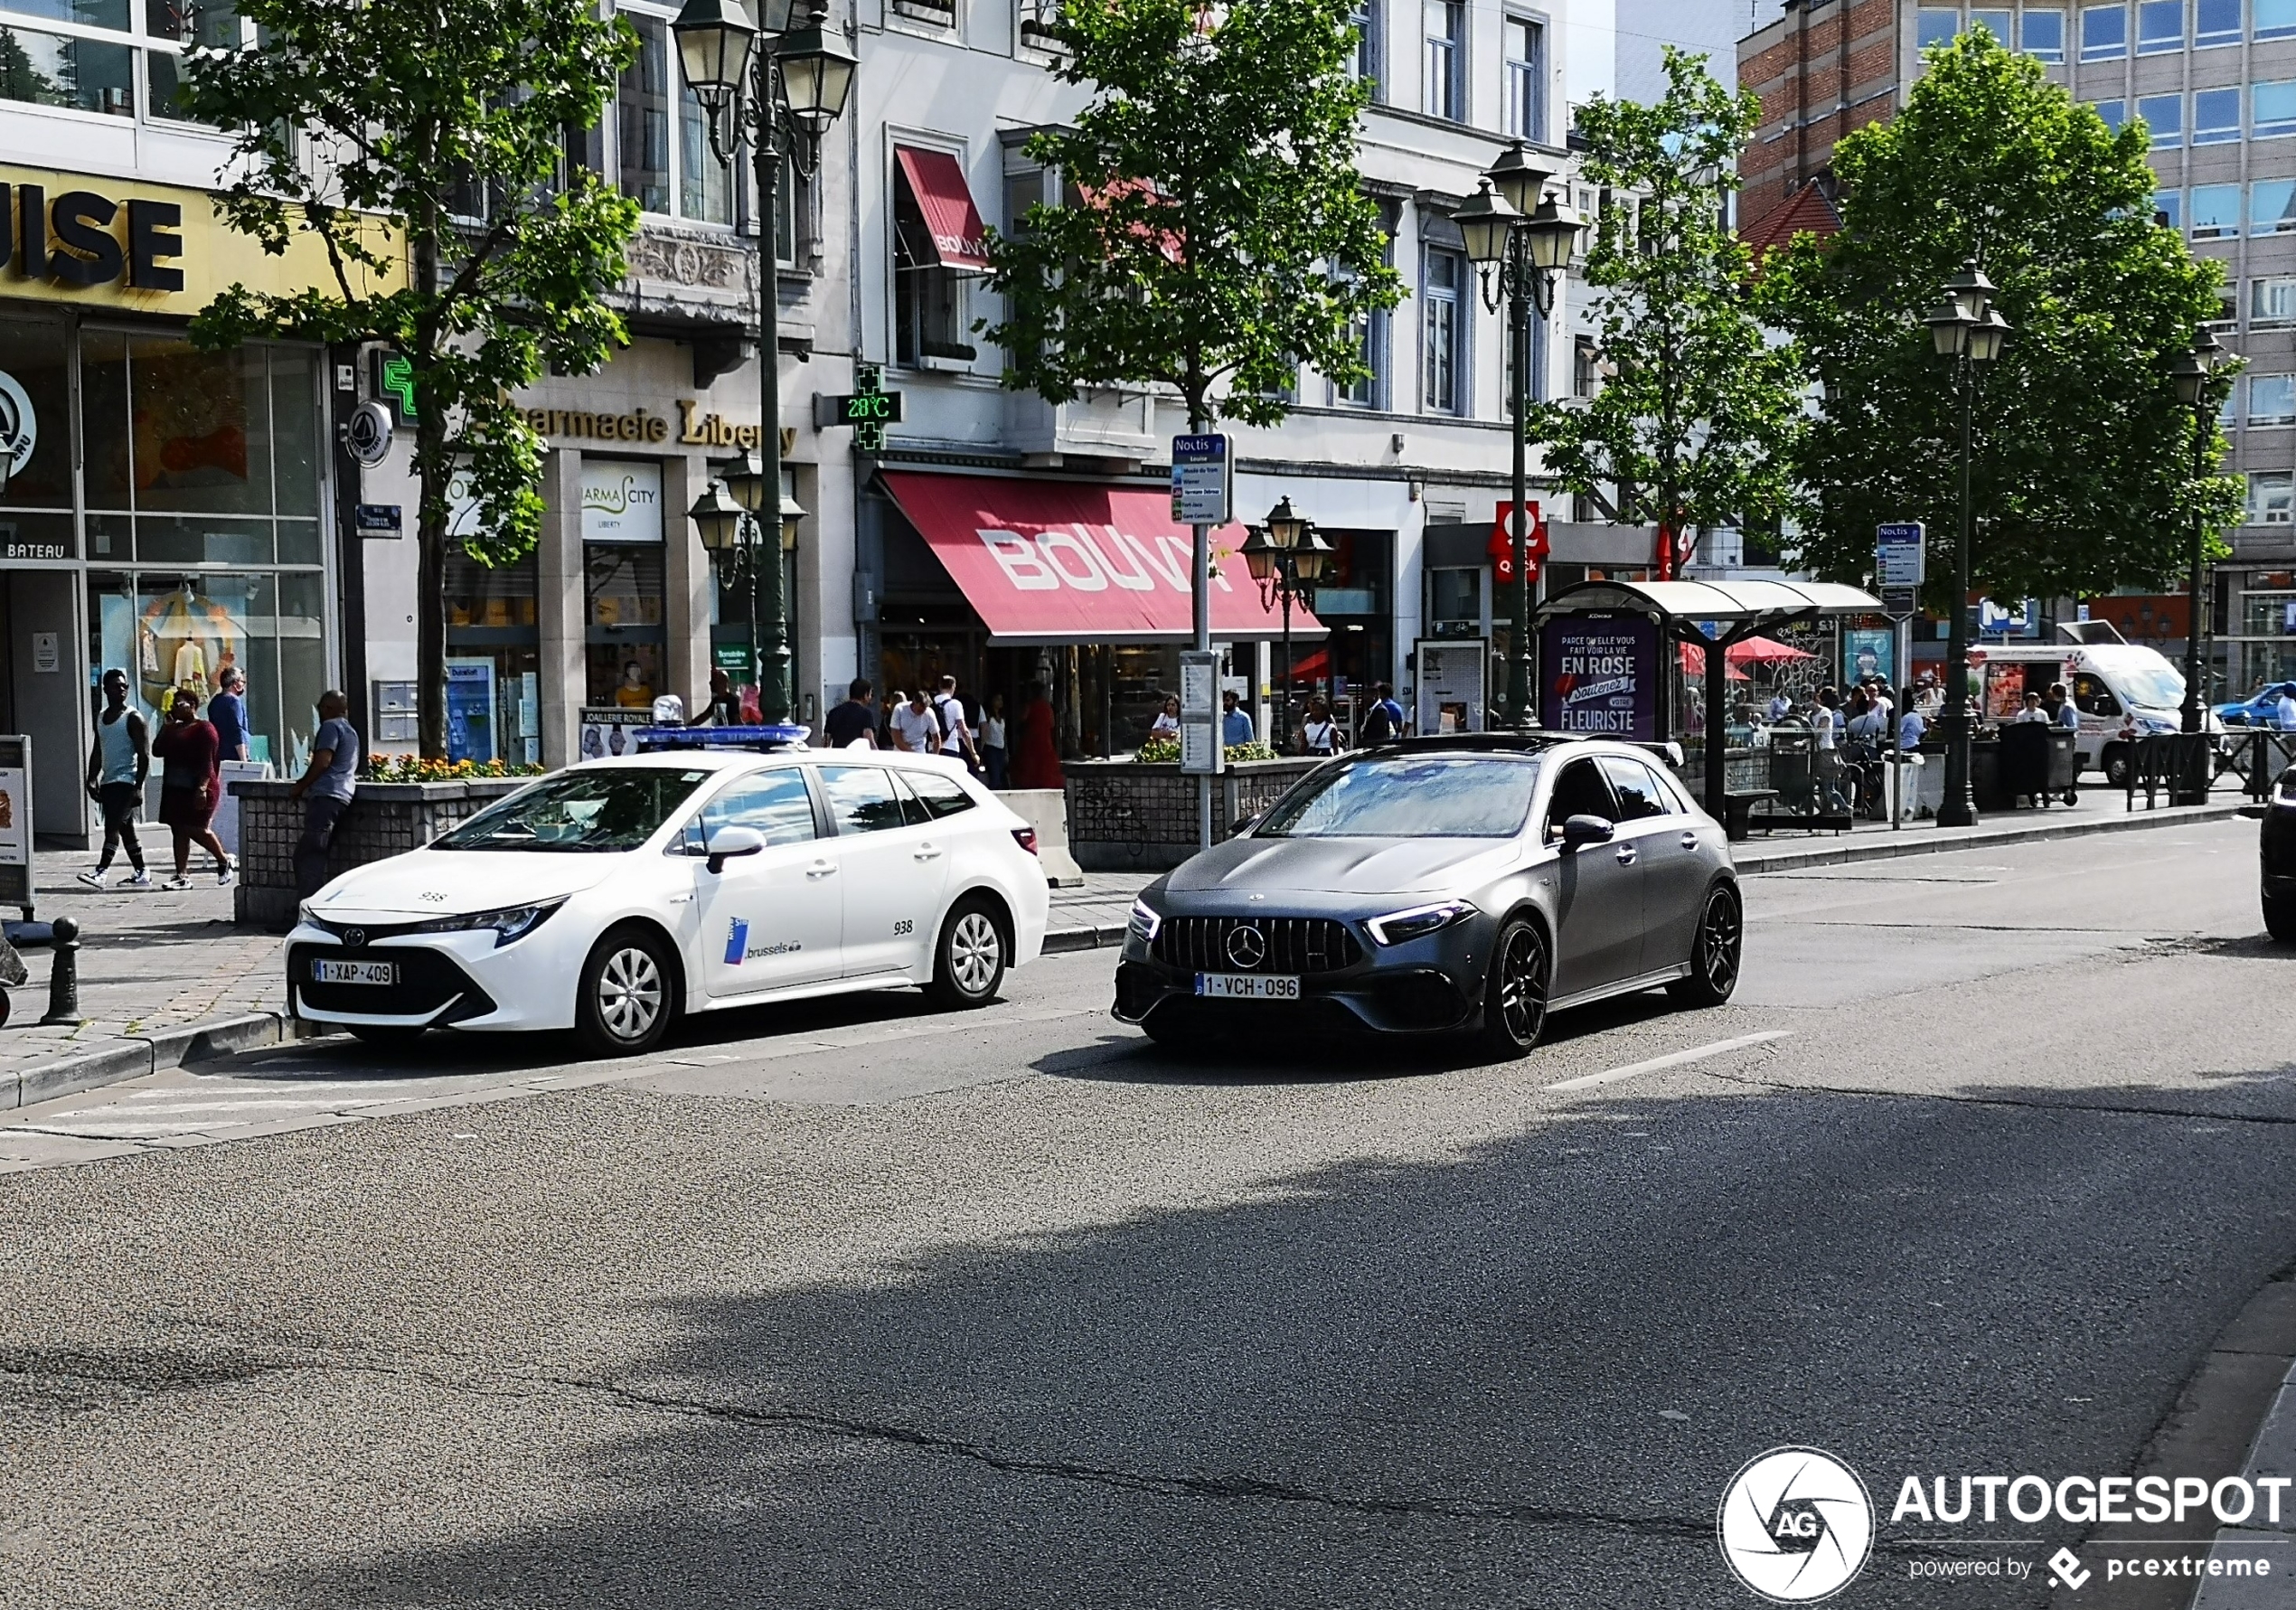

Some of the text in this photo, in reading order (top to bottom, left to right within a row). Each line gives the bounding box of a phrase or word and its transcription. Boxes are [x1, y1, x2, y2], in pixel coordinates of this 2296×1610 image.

[0, 183, 184, 292] ISE
[935, 234, 990, 258] BOUVY
[848, 397, 889, 417] 28°C
[474, 387, 797, 458] armacie Libery
[1176, 438, 1209, 451] Noctis
[598, 521, 621, 529] LIBERTY
[7, 543, 64, 559] BATEAU
[1561, 636, 1636, 645] PARCE QU'ELLE VOUS
[1569, 646, 1627, 654] FAIT VOIR LA VIE
[1561, 656, 1635, 674] EN ROSE
[1575, 678, 1623, 700] Soutenez
[1611, 698, 1631, 706] VOTRE
[585, 711, 652, 724] JOAILLERIE ROYALE
[1561, 710, 1634, 730] FLEURISTE
[419, 891, 448, 902] 938
[894, 919, 913, 936] 938
